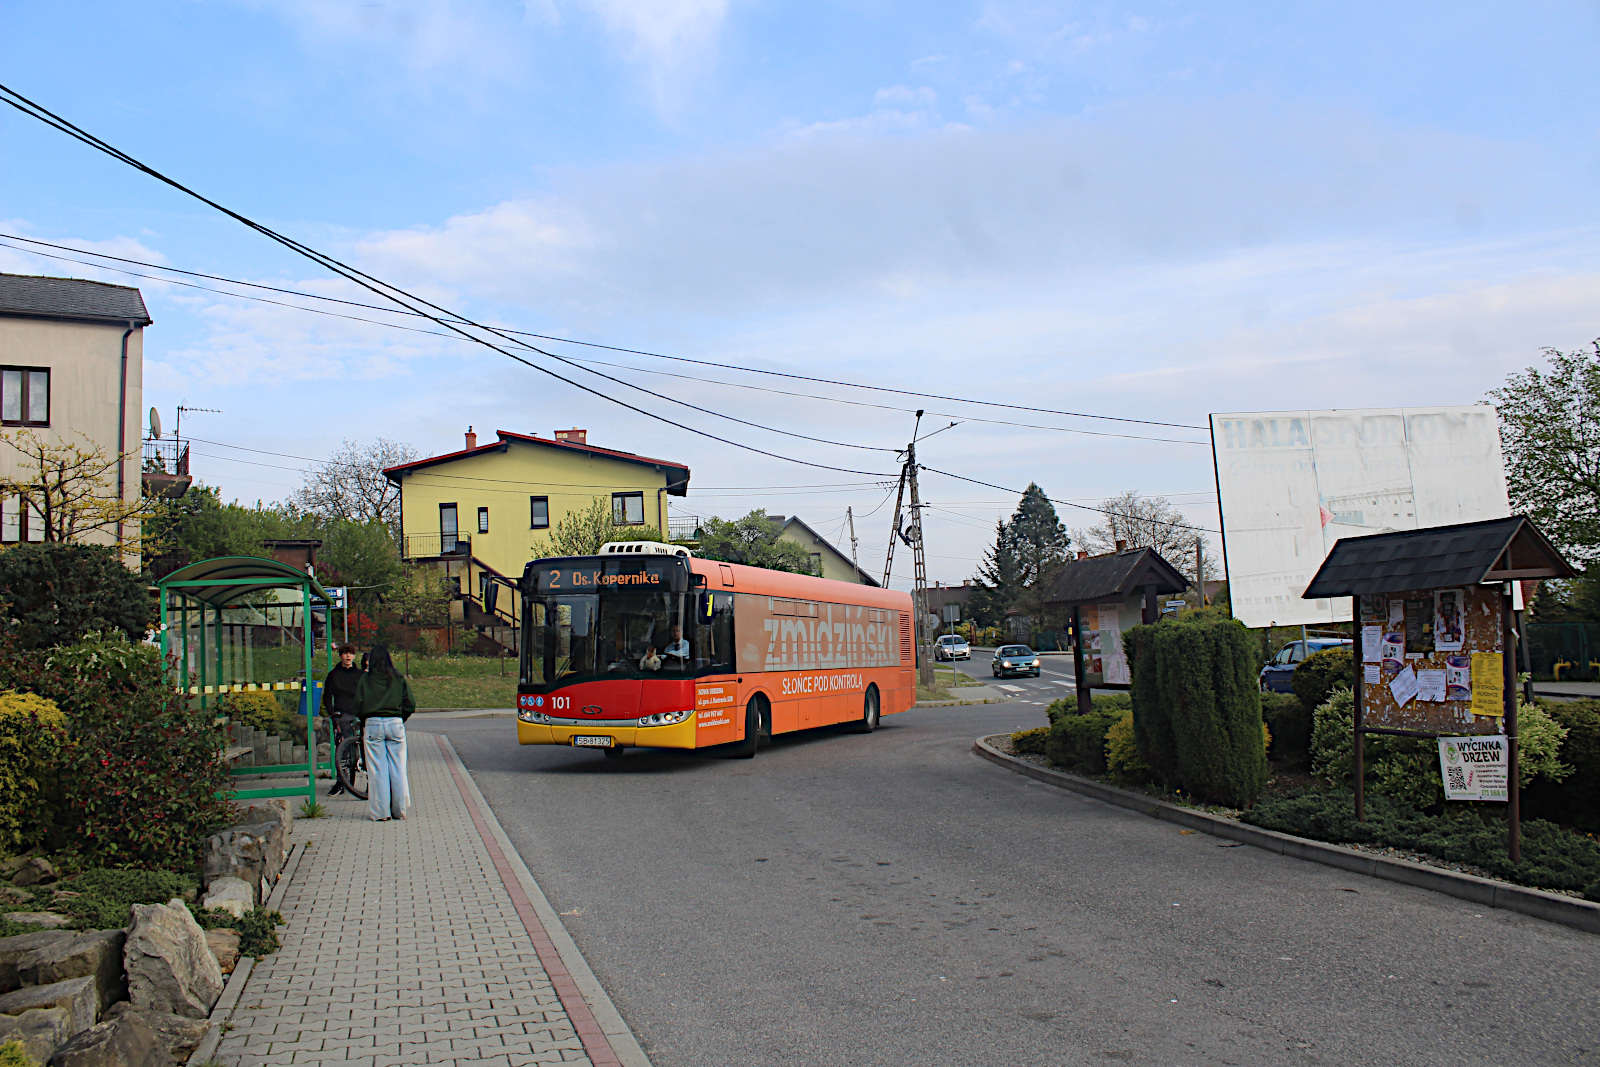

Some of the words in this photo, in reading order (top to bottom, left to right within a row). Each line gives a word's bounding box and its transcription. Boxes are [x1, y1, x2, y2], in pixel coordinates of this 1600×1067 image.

[1223, 418, 1309, 449] HALA
[549, 569, 560, 588] 2
[572, 571, 592, 586] Os.
[593, 570, 660, 586] Kopernika
[782, 673, 812, 695] SŁOŃCE
[813, 675, 828, 691] POD
[829, 674, 863, 690] KONTROLĄ
[551, 696, 570, 709] 101
[1457, 741, 1502, 752] WYCINKA
[1462, 751, 1500, 763] DRZEW
